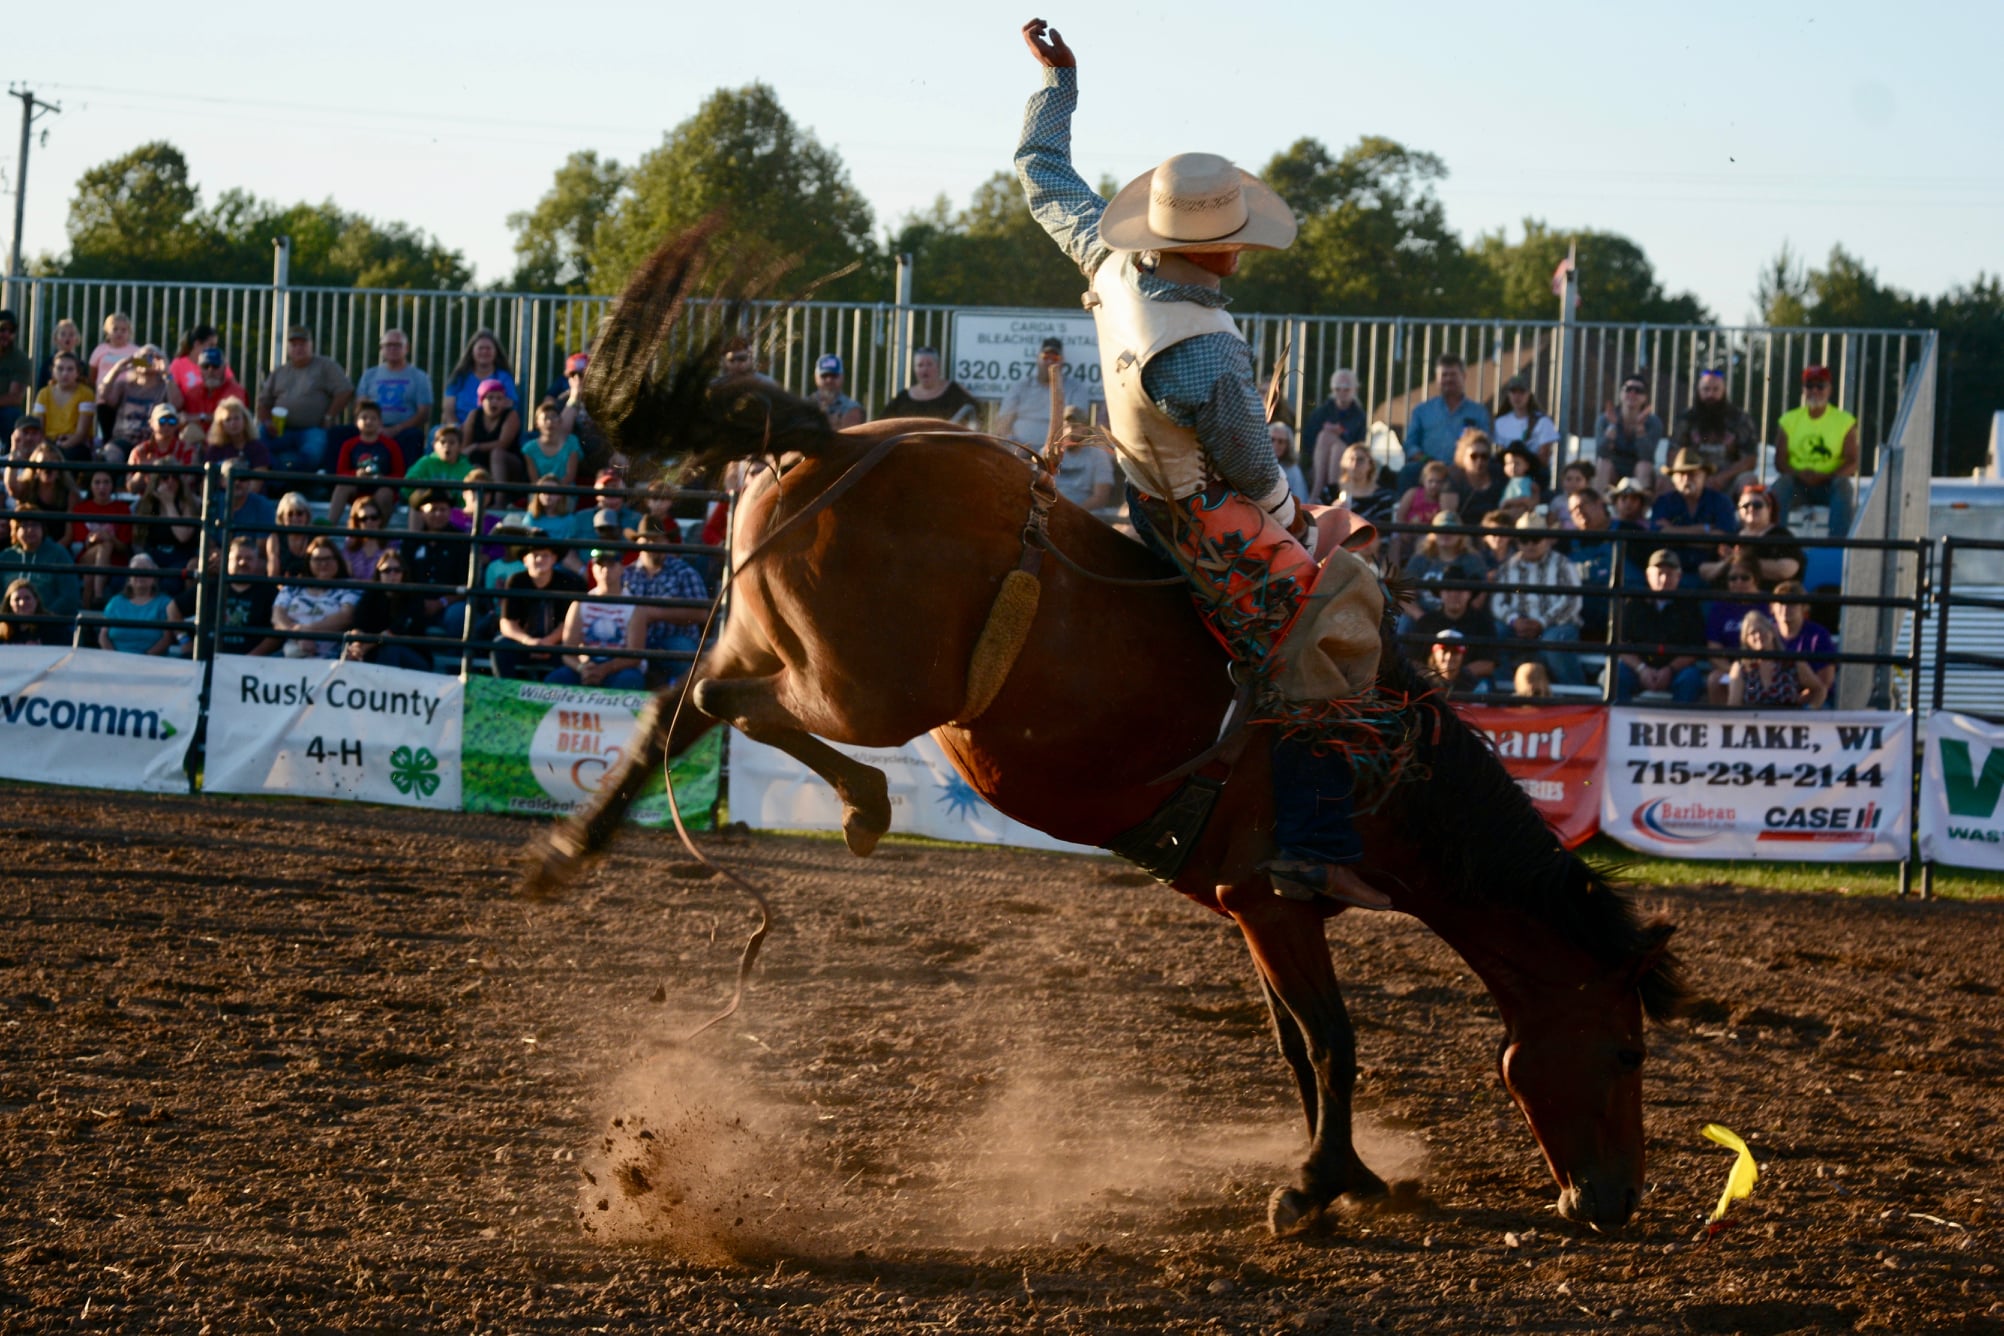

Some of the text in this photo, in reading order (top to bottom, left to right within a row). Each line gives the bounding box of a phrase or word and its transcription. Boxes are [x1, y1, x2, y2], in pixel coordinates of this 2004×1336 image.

[241, 675, 440, 725] Rusk County
[521, 685, 648, 708] Wildlife's First Ch
[558, 710, 604, 733] REAL
[557, 732, 602, 755] DEAL
[1485, 726, 1566, 760] art
[1628, 722, 1884, 754] RICE LAKE, WI
[306, 736, 363, 767] 4-H
[1627, 760, 1885, 788] 715-234-2144
[1764, 806, 1851, 829] CASE
[1948, 827, 2004, 843] WAS
